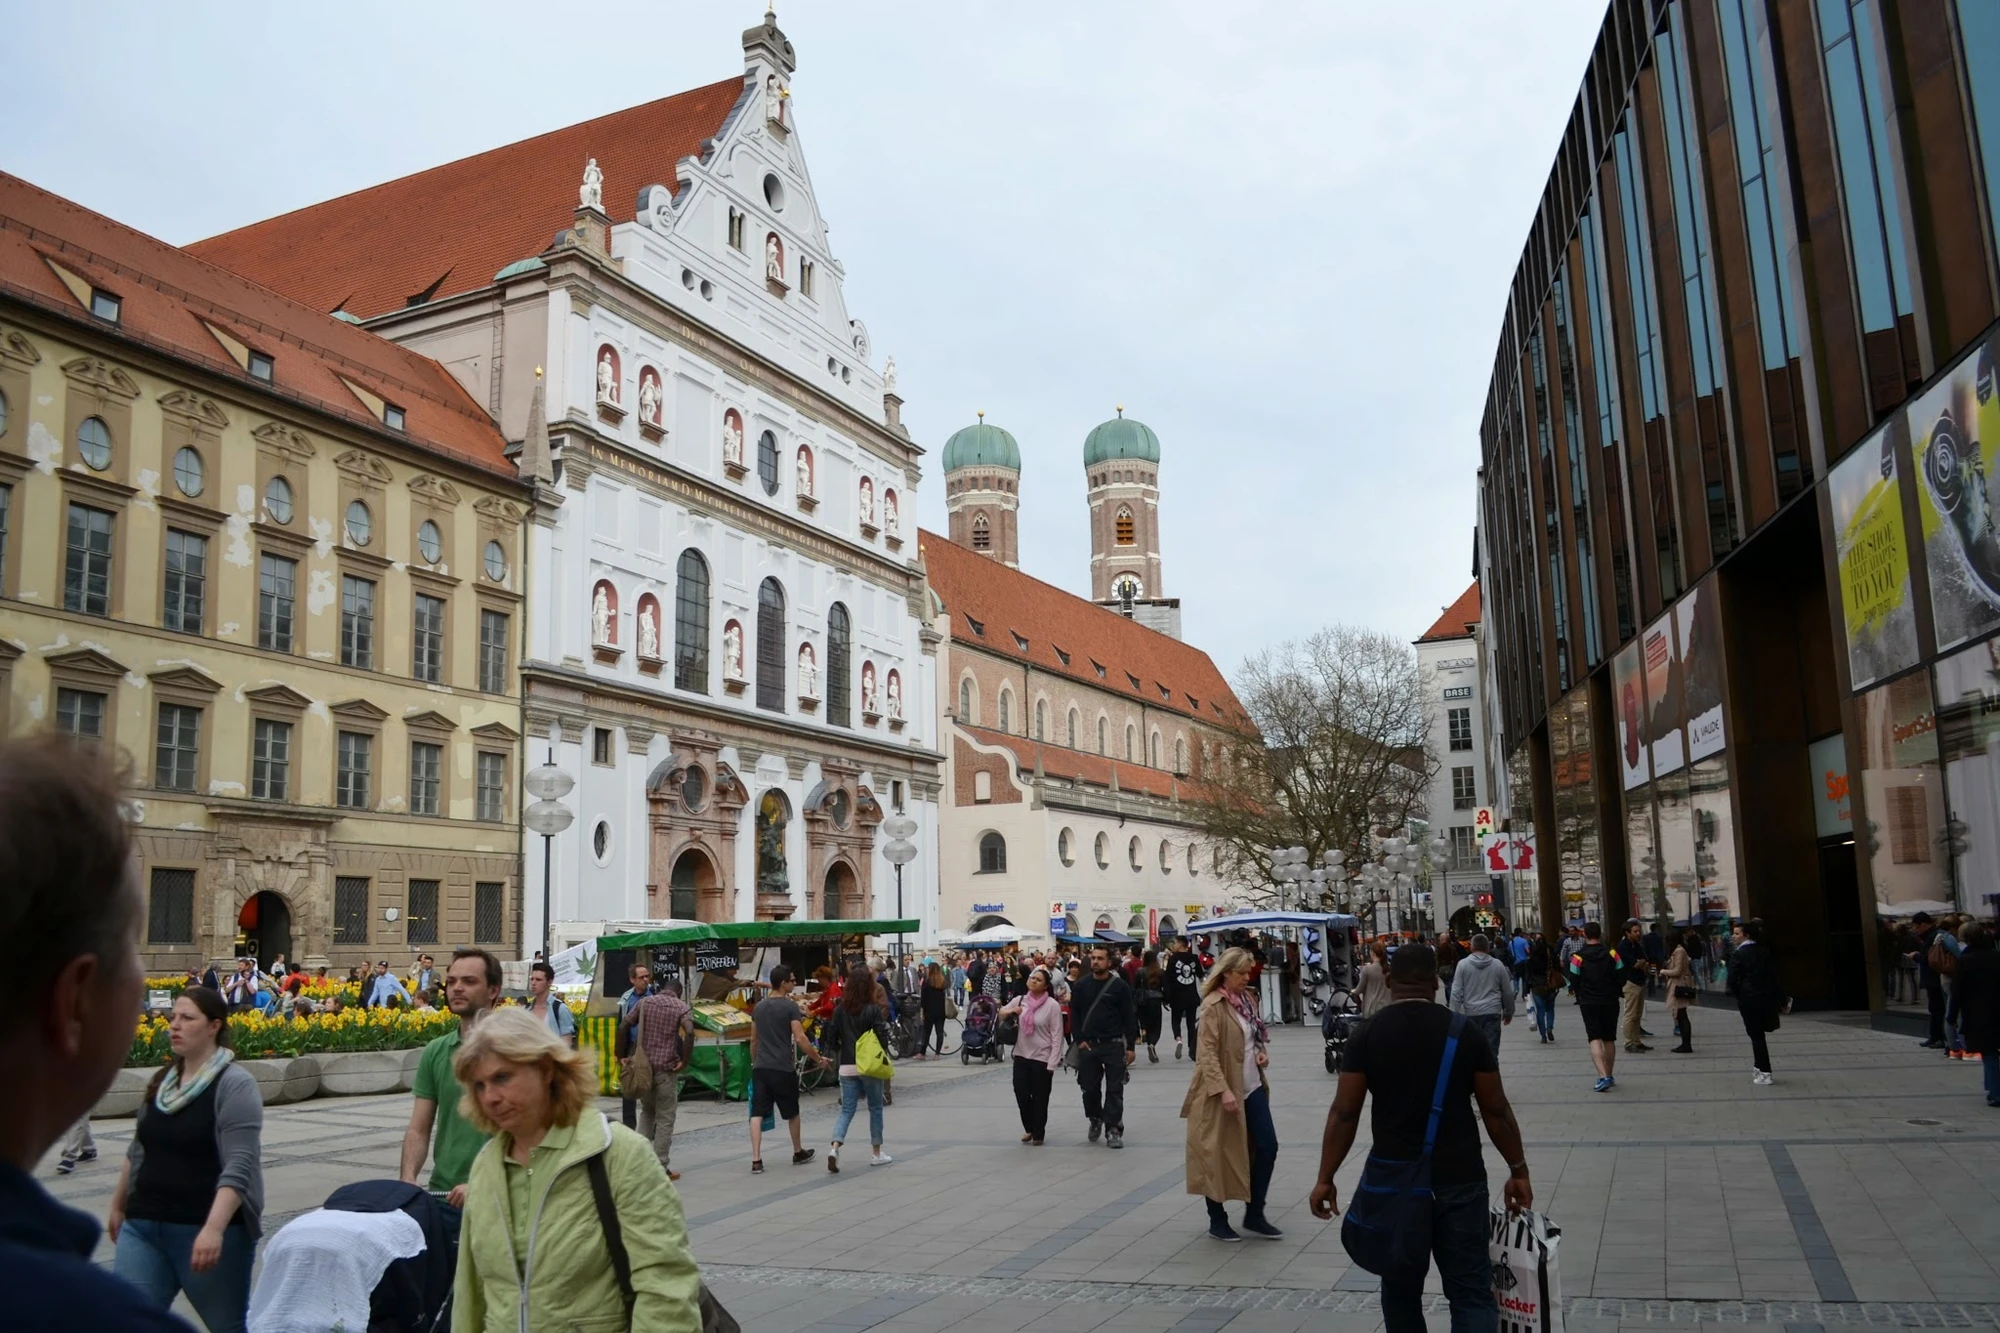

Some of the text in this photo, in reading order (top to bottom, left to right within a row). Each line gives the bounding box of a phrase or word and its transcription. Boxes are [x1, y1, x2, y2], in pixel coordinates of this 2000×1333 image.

[591, 445, 604, 461] IN
[610, 453, 678, 491] MEMORIAM
[1848, 540, 1867, 568] THE
[1867, 520, 1895, 552] SHOE
[1849, 545, 1897, 584] THAT ADAPTS
[1850, 559, 1898, 610] TO YOU
[1445, 687, 1470, 697] BASE
[1700, 719, 1720, 737] VAUDE
[973, 902, 1005, 913] Rischart
[695, 956, 738, 971] ERDBEEREN
[1499, 1292, 1536, 1314] Locker
